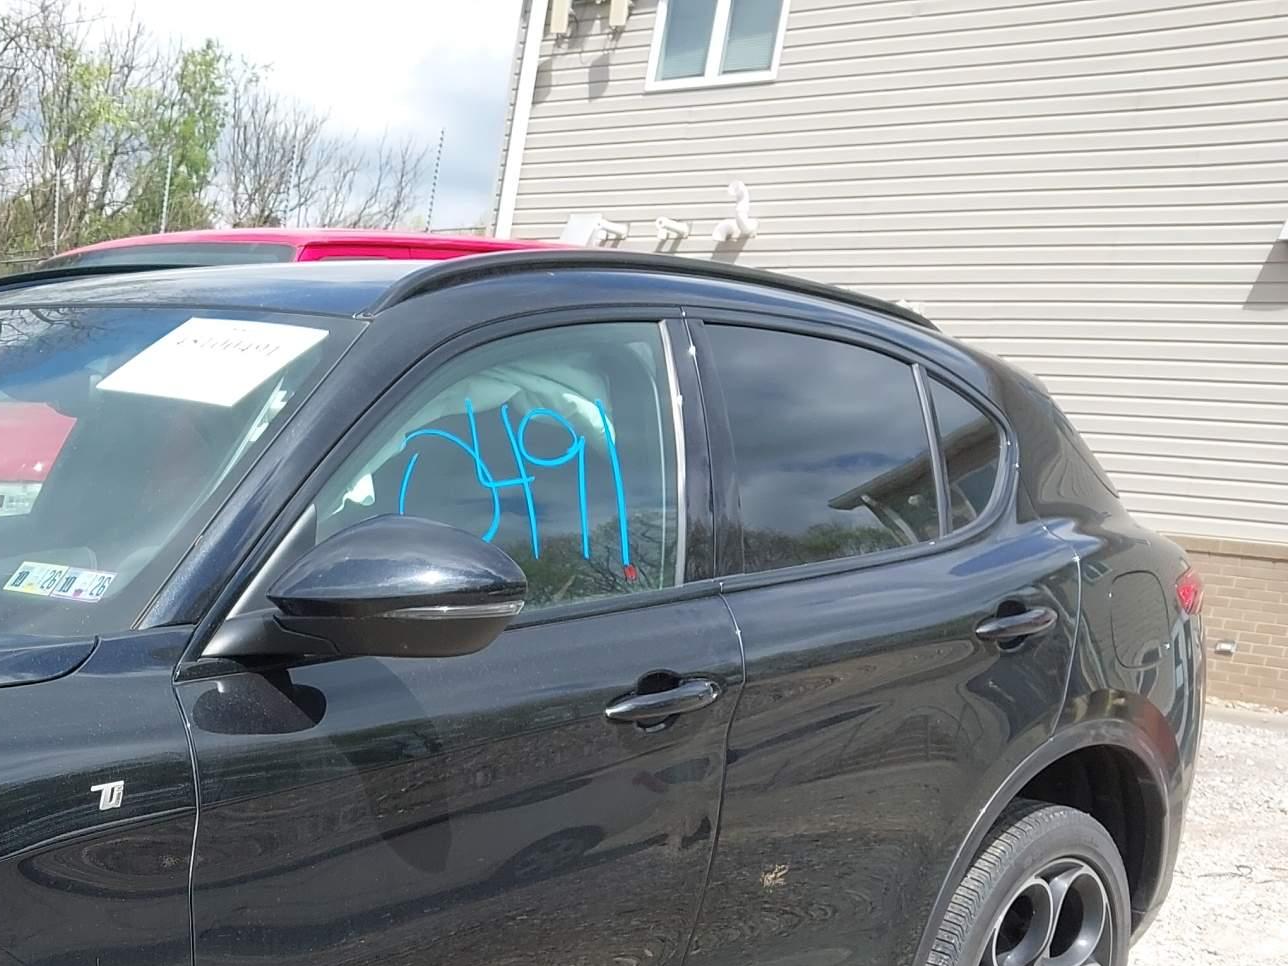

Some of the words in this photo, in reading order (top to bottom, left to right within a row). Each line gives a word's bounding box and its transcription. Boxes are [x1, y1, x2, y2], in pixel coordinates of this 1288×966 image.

[40, 569, 63, 590] 26
[58, 575, 78, 593] 10
[88, 574, 112, 597] 26
